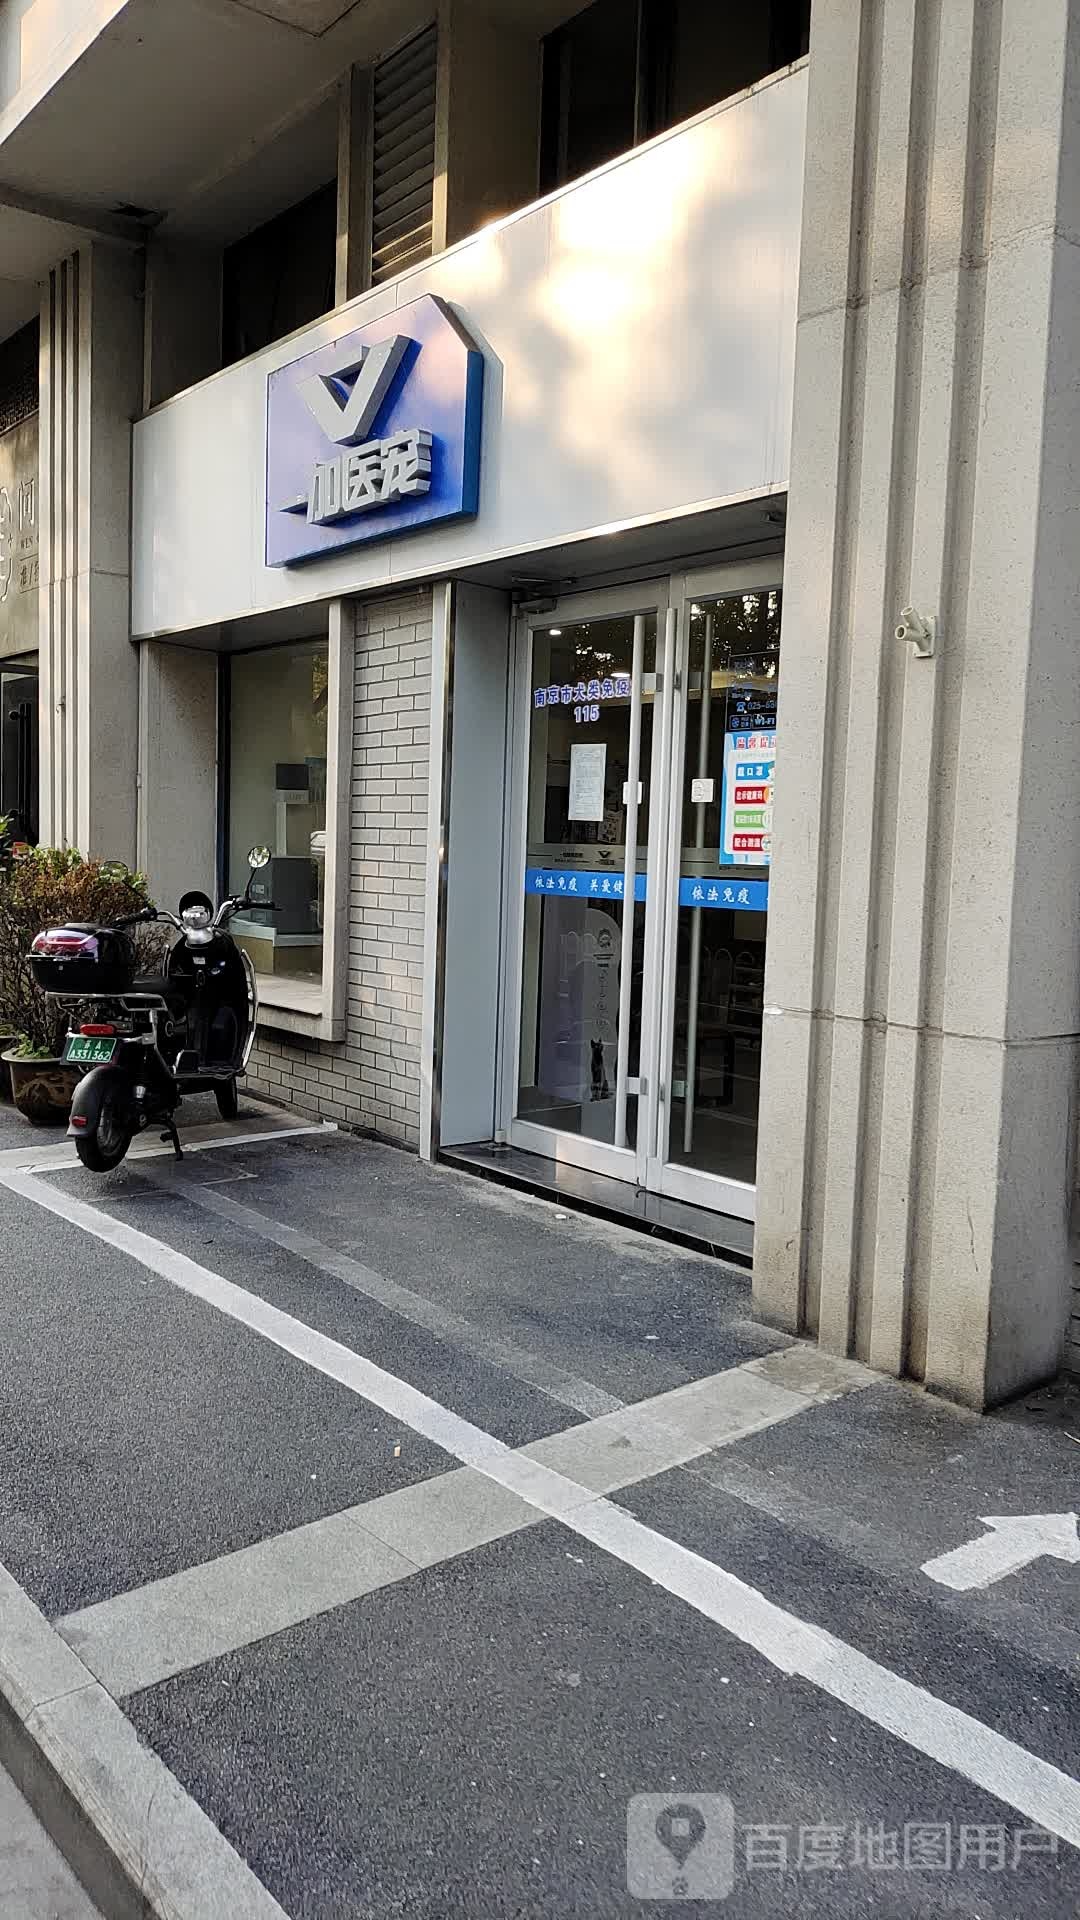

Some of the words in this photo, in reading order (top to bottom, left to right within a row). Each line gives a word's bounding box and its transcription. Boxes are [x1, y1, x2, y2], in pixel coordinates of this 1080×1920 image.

[534, 678, 631, 708] 南京市犬类免疫
[574, 704, 600, 723] 115
[534, 875, 578, 892] 依法免疫
[590, 878, 625, 894] 关爱健
[692, 885, 750, 905] 依法免疫
